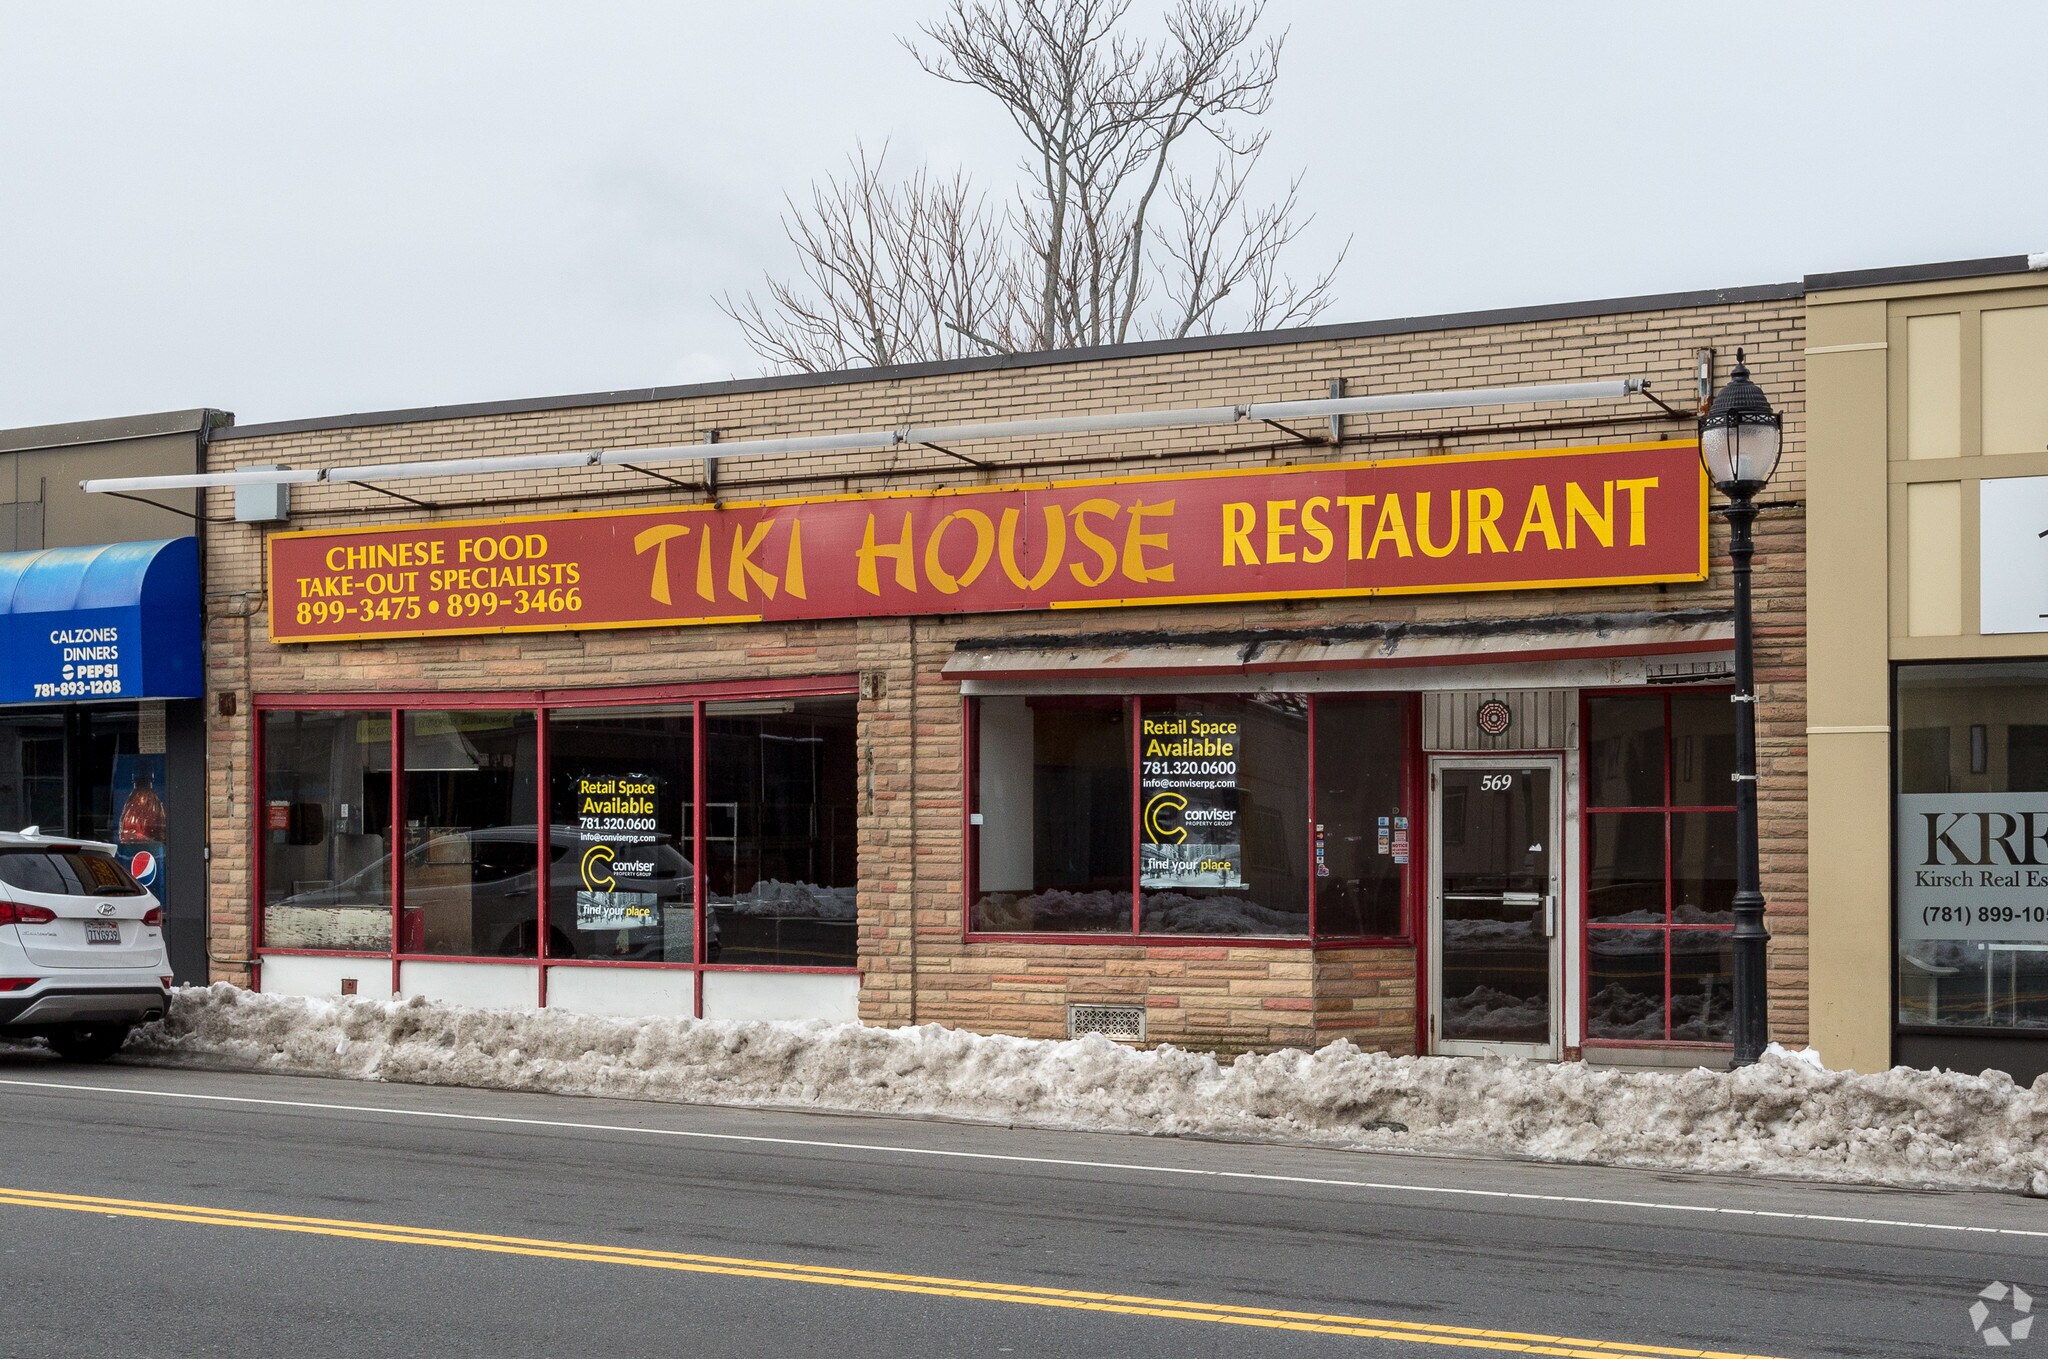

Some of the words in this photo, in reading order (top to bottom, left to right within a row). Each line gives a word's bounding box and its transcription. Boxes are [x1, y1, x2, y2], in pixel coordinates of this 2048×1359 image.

[633, 517, 807, 606] TIKI
[856, 498, 1176, 597] HOUSE
[1221, 476, 1659, 567] RESTAURANT
[325, 541, 445, 571] CHINESE
[458, 534, 548, 563] FOOD
[296, 571, 419, 598] TAKE-OUT
[430, 562, 580, 591] SPECIALISTS
[296, 596, 421, 625] 899-3475
[447, 587, 582, 617] 899-3466
[50, 627, 118, 645] CALZONES
[63, 645, 119, 662] DINNERS
[77, 664, 118, 679] PEPSI
[34, 680, 121, 697] 781-893-1208
[1143, 719, 1187, 735] Retail
[1191, 719, 1237, 737] Space
[1146, 738, 1233, 757] Available
[1142, 761, 1237, 775] 781.320.0600
[581, 780, 616, 794] Retail
[618, 780, 656, 797] Space
[1143, 778, 1235, 789] info@conviserpg.com
[1480, 774, 1512, 791] 569
[582, 797, 654, 814] Available
[1184, 808, 1237, 821] conviser
[579, 817, 656, 830] 781.320.0600
[580, 832, 656, 843] info@conviserpg.com
[612, 860, 655, 872] conviser
[1147, 858, 1169, 870] find
[1172, 860, 1198, 872] your
[1200, 859, 1231, 872] place
[1914, 870, 1974, 887] Kirsch
[1979, 870, 2020, 887] Real
[583, 903, 602, 915] find
[603, 906, 625, 918] your
[626, 905, 651, 917] place
[1922, 906, 1972, 926] (781)
[1978, 906, 2048, 923] 899-10
